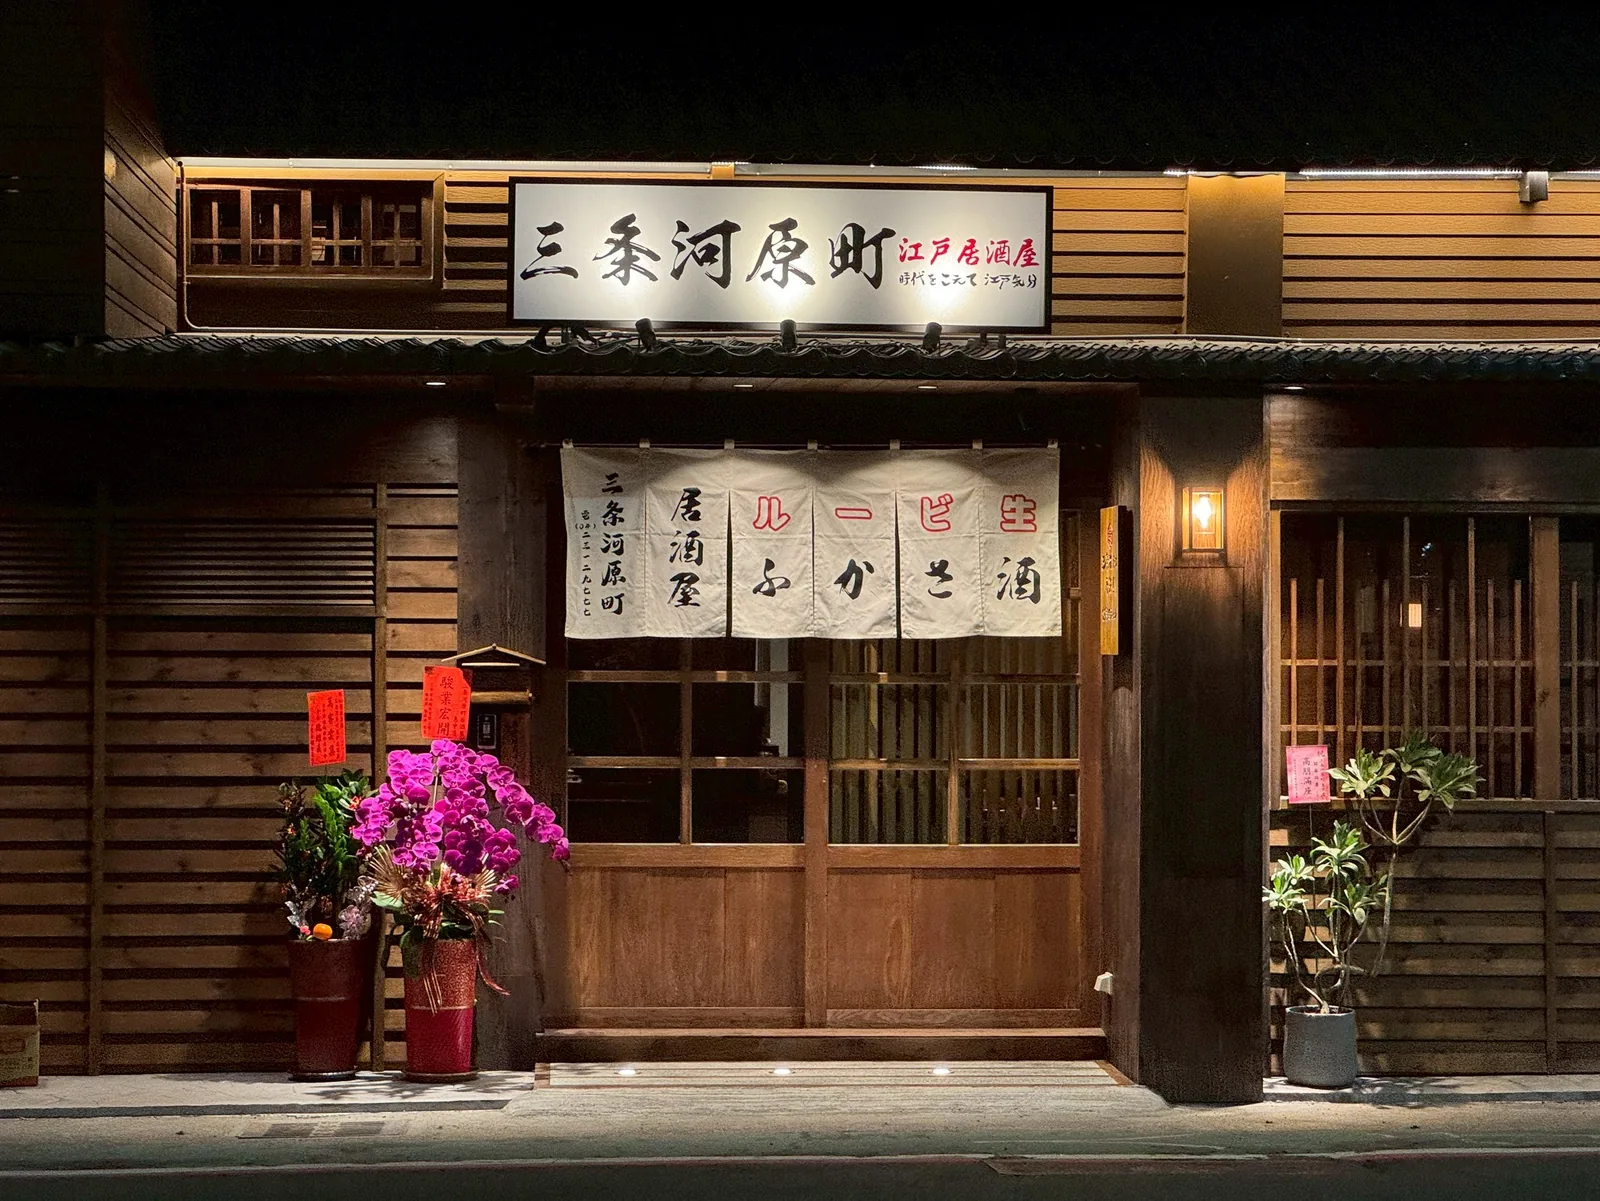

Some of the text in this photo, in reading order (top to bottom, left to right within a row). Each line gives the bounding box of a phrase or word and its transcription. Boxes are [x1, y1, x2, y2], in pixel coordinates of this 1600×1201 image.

[519, 212, 898, 290] 三条河原町
[898, 236, 1040, 268] 江戸居酒屋
[600, 472, 627, 616] 三条河原町
[667, 486, 704, 609] 居酒屋
